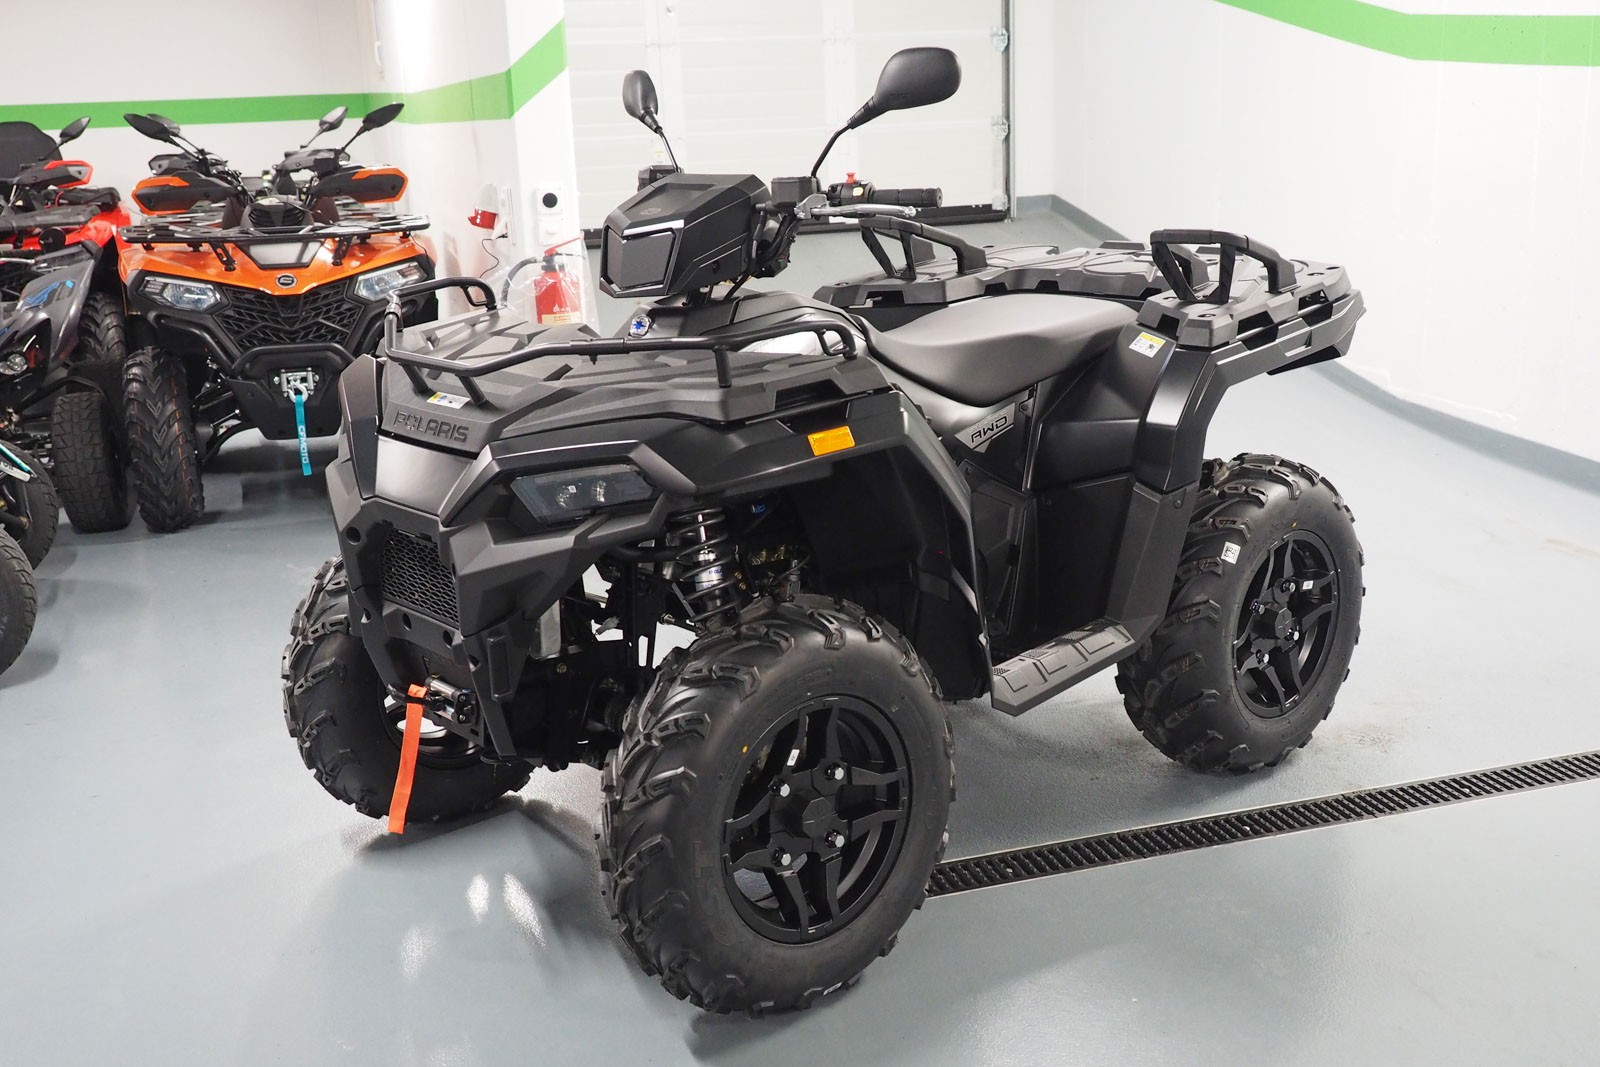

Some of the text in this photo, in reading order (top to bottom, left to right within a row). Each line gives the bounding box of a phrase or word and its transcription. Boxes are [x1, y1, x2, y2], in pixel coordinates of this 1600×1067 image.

[393, 410, 470, 443] POLARIS
[971, 415, 1008, 443] AWD
[298, 425, 309, 464] CFMOTO
